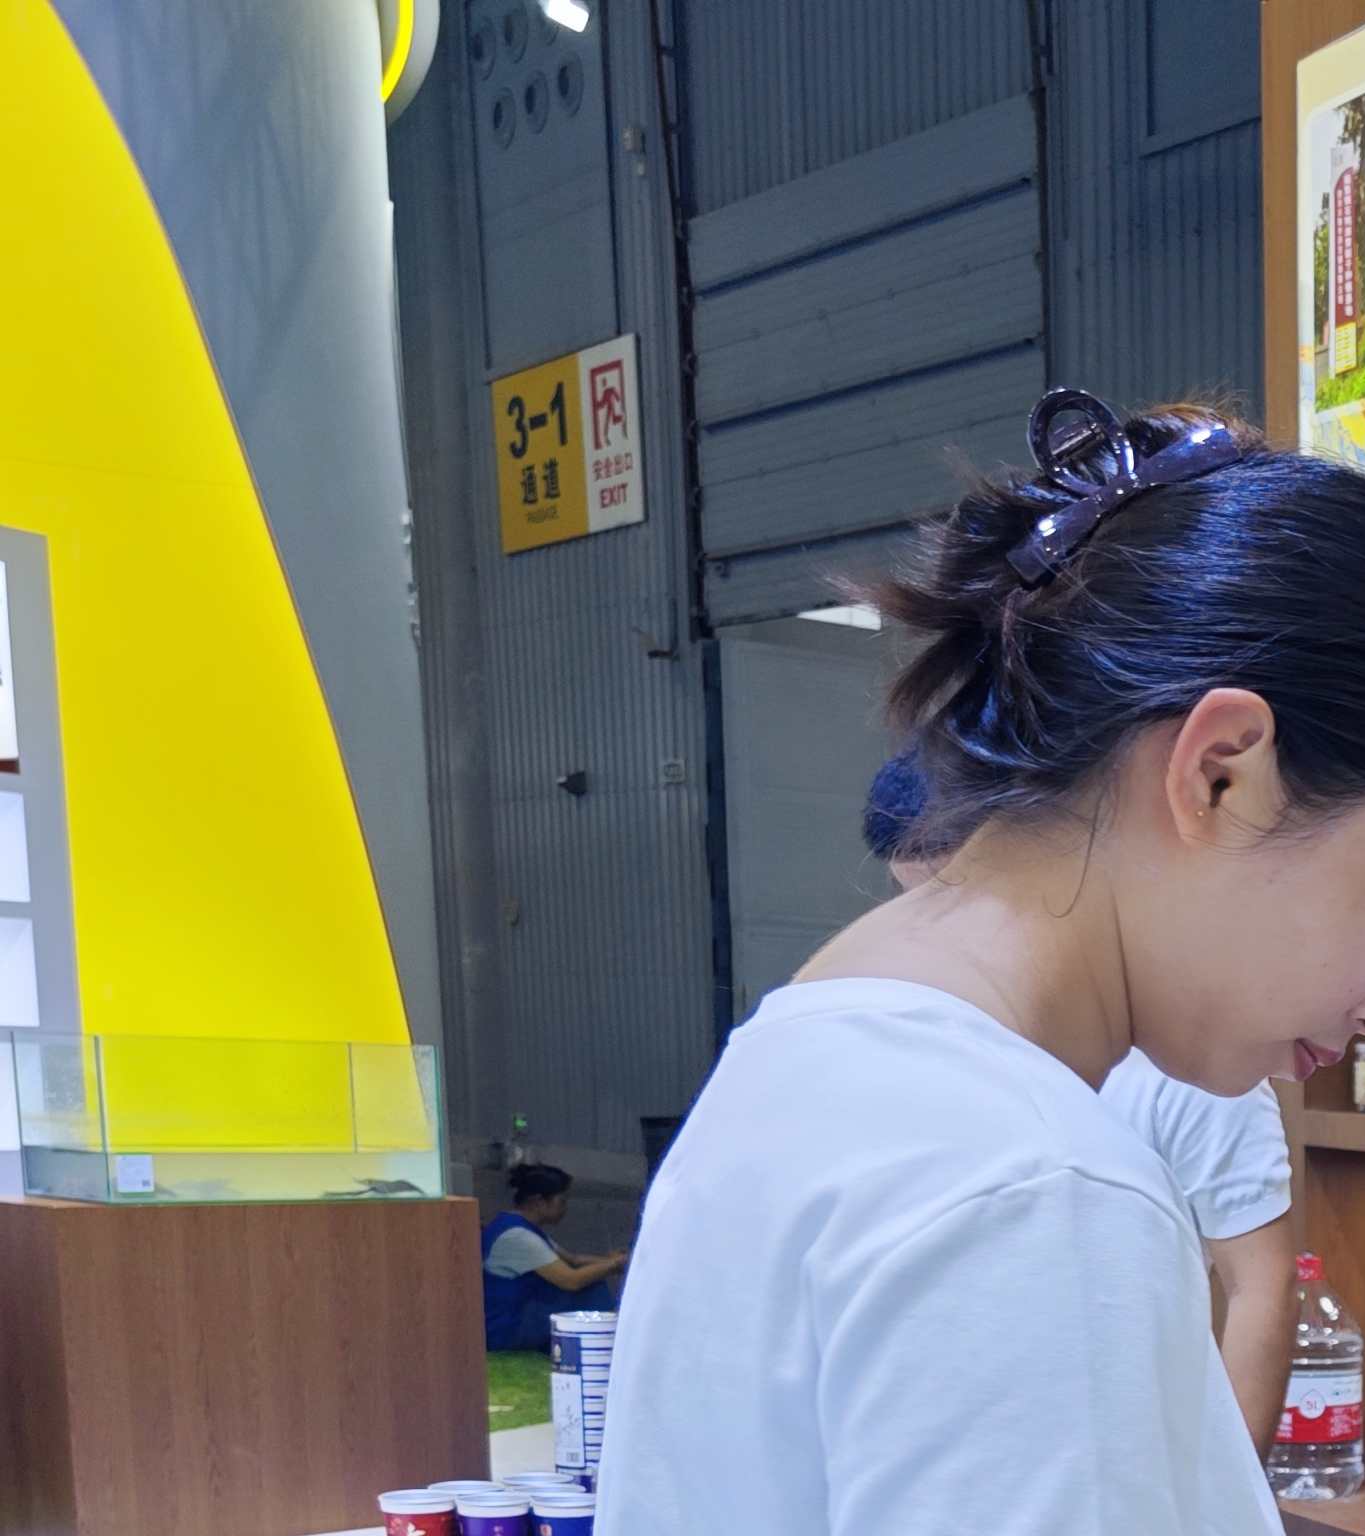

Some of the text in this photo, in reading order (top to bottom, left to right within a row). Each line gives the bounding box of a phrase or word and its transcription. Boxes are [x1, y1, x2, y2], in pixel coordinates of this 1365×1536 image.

[507, 381, 568, 459] 3-1
[520, 457, 561, 505] 通道
[592, 452, 634, 482] 安全出口
[600, 482, 629, 509] EXIT
